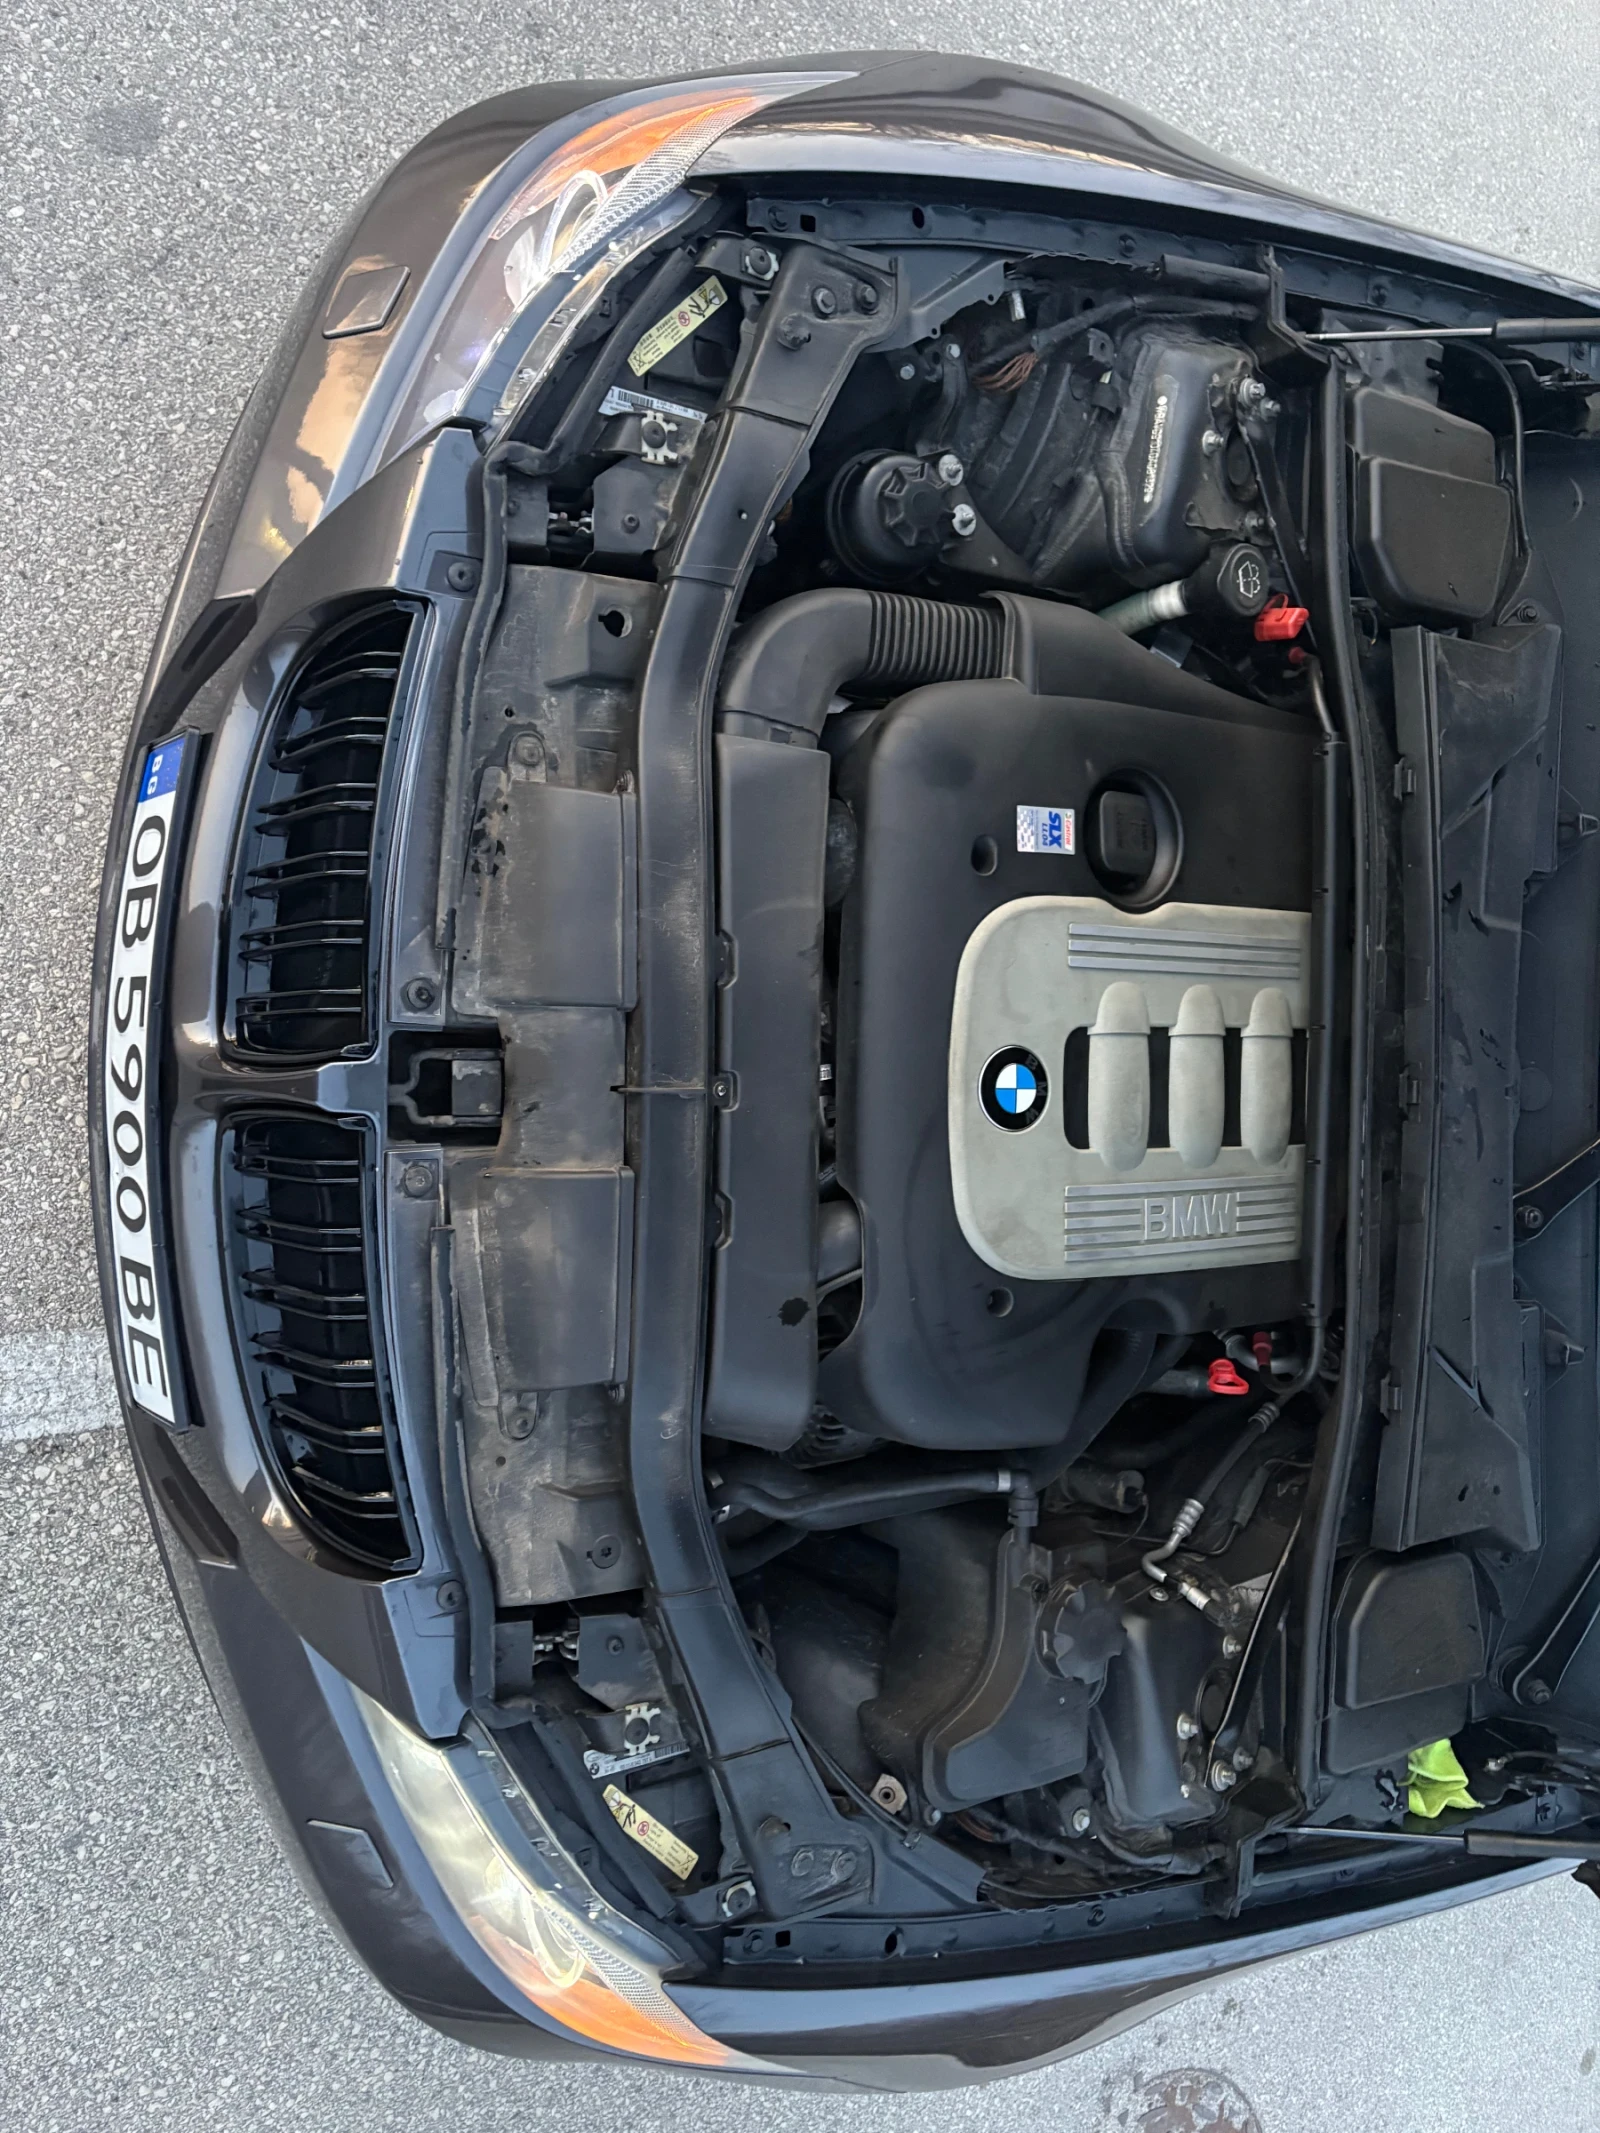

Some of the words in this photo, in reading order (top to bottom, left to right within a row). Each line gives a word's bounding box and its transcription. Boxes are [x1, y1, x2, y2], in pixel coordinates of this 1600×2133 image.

[146, 753, 164, 795] BG
[1048, 810, 1062, 849] SLX
[1064, 819, 1072, 846] Castrol
[121, 815, 166, 949] OB
[111, 975, 148, 1233] 5900
[1025, 1054, 1047, 1124] BMW
[1143, 1193, 1233, 1242] BMW
[119, 1255, 168, 1397] BE
